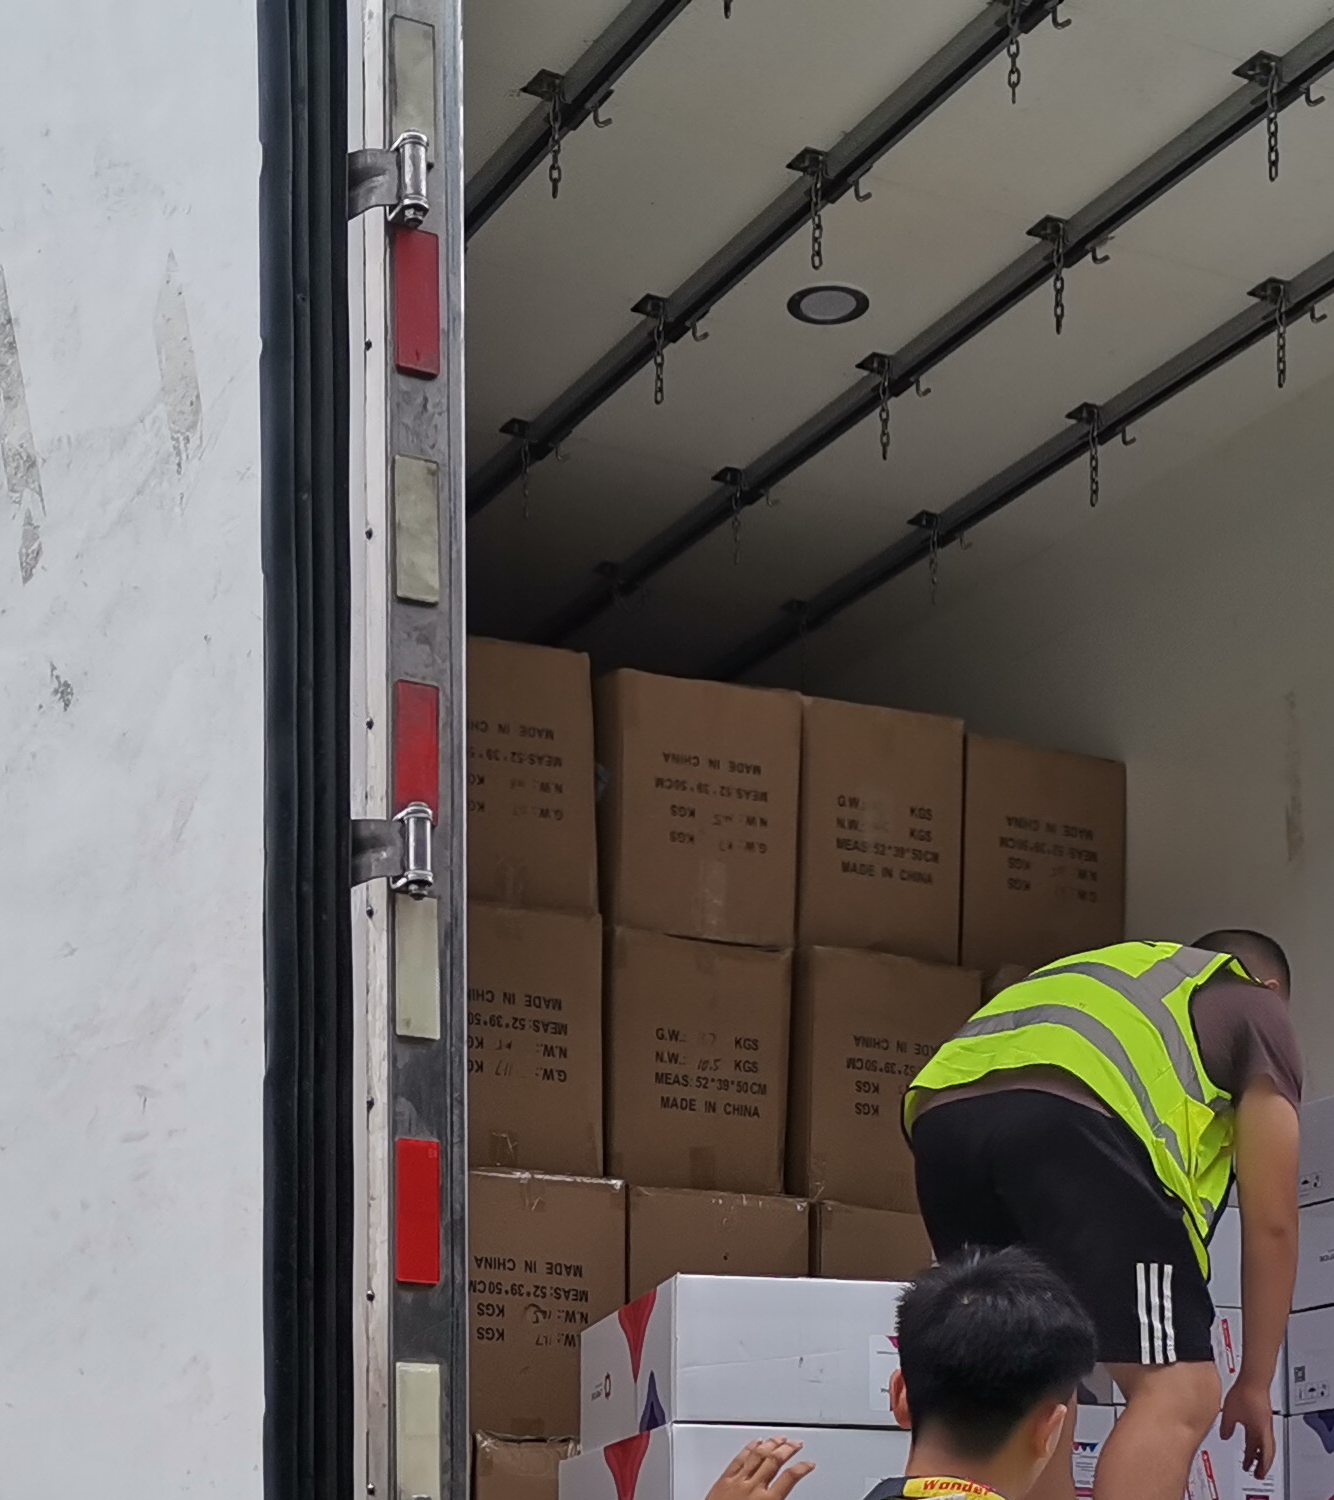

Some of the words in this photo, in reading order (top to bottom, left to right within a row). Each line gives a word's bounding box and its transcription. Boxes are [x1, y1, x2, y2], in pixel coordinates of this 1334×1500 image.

[662, 752, 700, 767] CHINA
[708, 758, 721, 770] IN
[728, 761, 762, 776] MADE
[670, 804, 696, 818] KGS
[841, 861, 875, 877] MADE
[502, 991, 516, 1005] IN
[524, 994, 563, 1011] MADE
[734, 1036, 759, 1051] KGS
[853, 1034, 890, 1051] CHINA
[896, 1041, 908, 1054] IN
[734, 1059, 759, 1074] KGS
[854, 1080, 880, 1094] KGS
[660, 1096, 697, 1112] MADE
[704, 1100, 717, 1114] IN
[723, 1102, 760, 1119] CHINA
[854, 1102, 880, 1116] KGS
[474, 1255, 516, 1272] CHINA
[524, 1260, 537, 1273] IN
[545, 1261, 583, 1278] MADE
[476, 1302, 505, 1318] KGS
[476, 1326, 505, 1342] KGS
